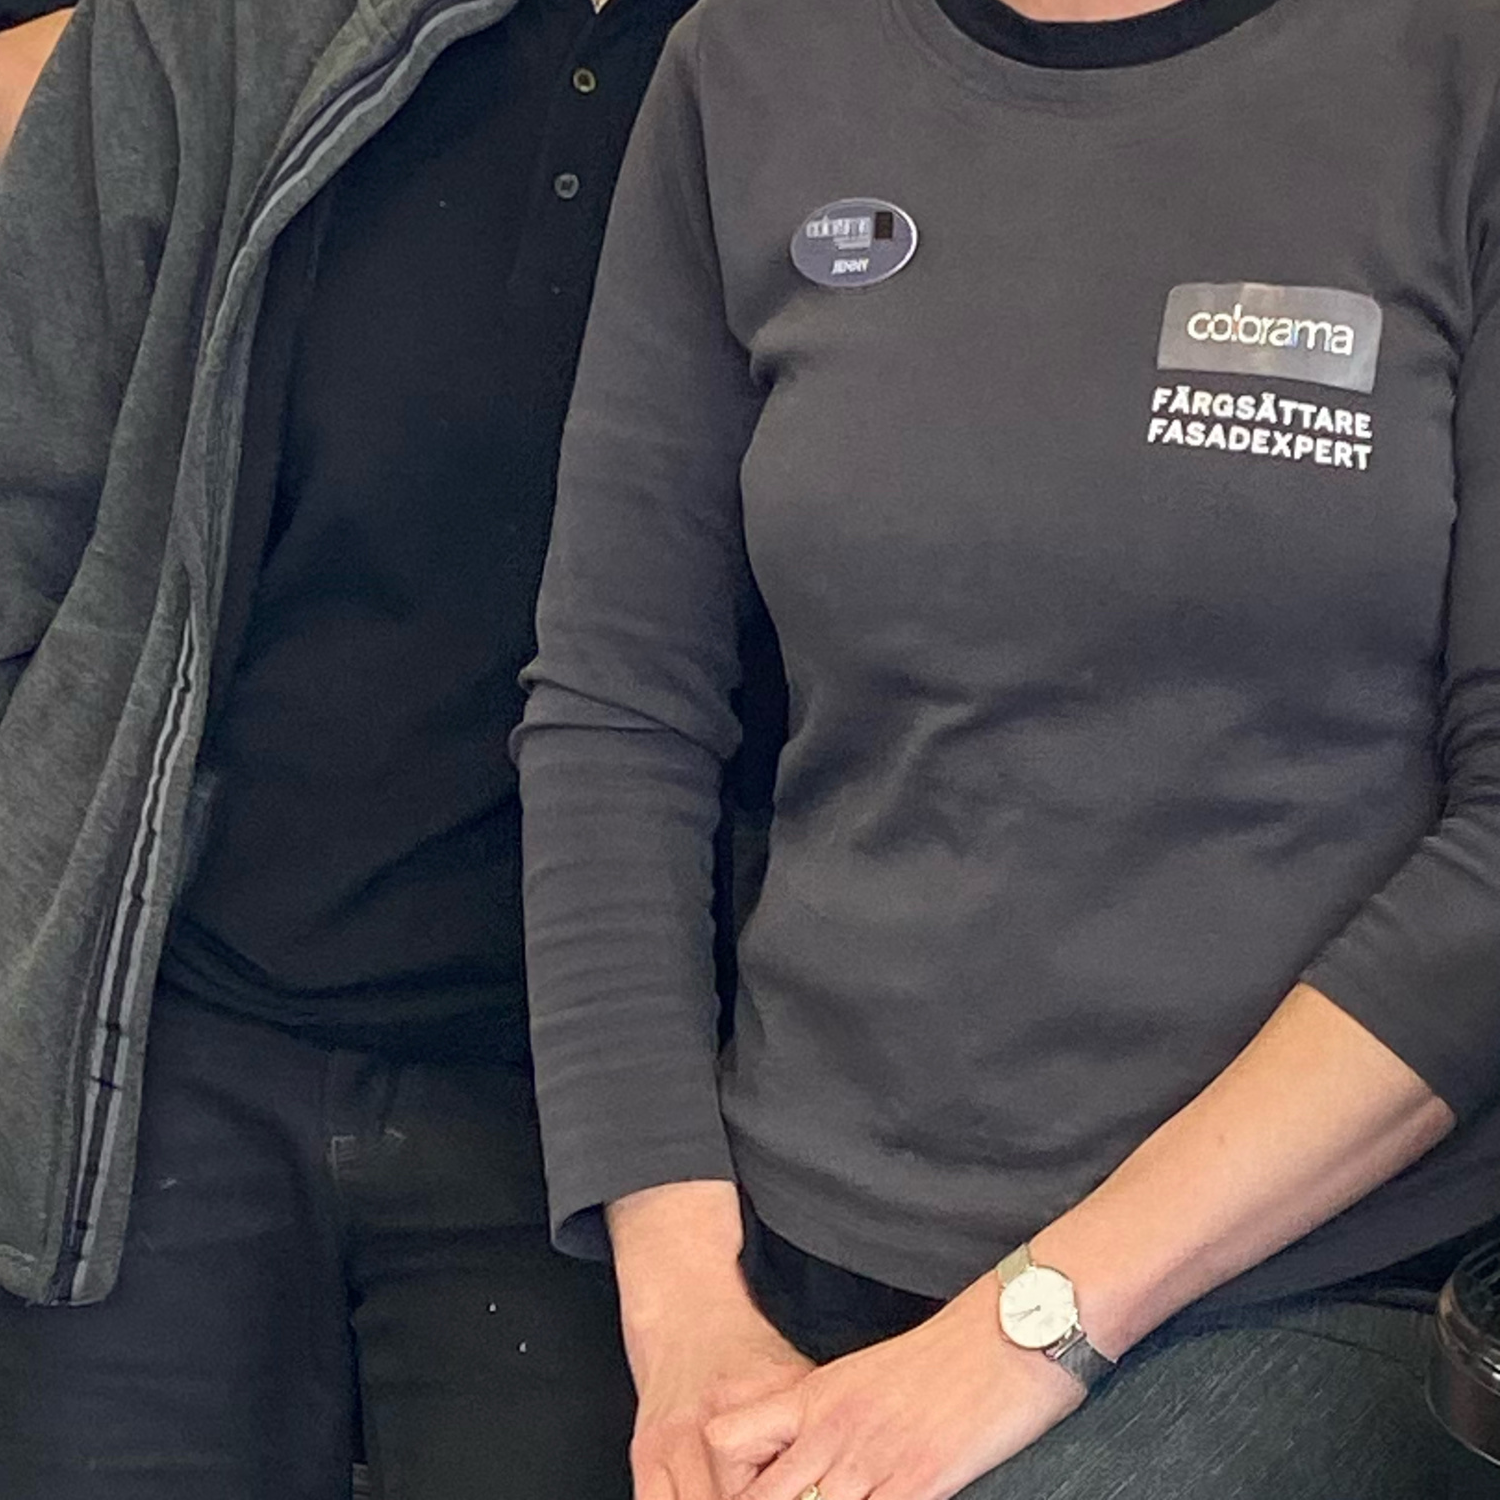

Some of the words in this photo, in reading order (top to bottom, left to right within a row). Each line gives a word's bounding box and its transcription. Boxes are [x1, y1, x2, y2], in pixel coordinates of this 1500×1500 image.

[1187, 303, 1355, 356] colorama
[1150, 385, 1373, 439] FÄRGSÄTTARE
[1147, 417, 1373, 471] FASADEXPERT
